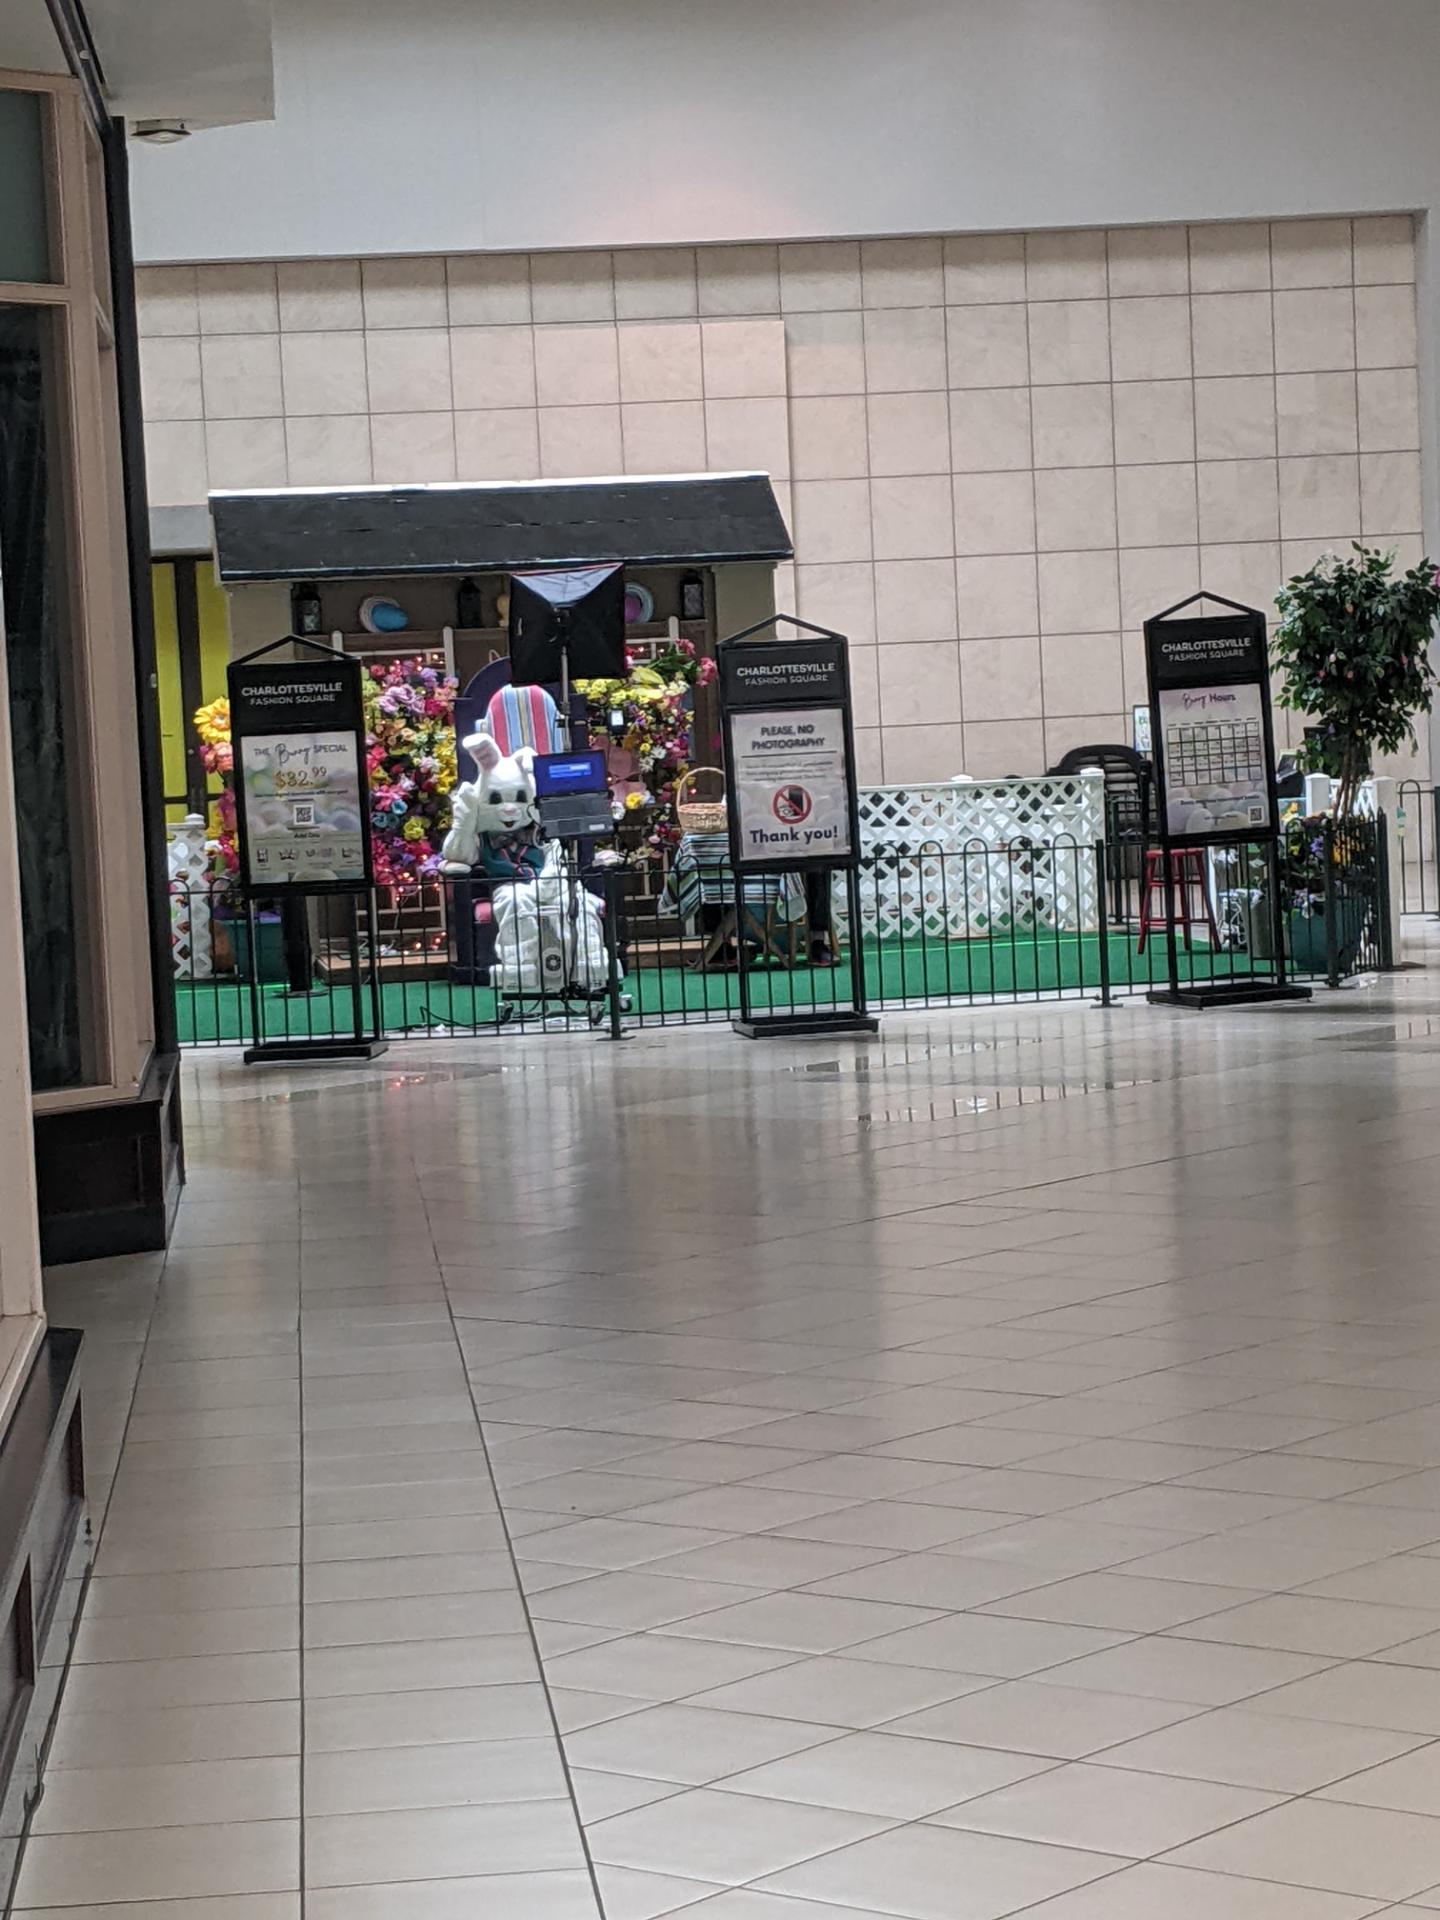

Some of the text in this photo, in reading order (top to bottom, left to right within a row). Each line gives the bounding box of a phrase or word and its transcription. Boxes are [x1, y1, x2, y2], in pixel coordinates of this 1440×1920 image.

[1161, 637, 1251, 653] CHARLOTTESVILLE
[1169, 649, 1244, 662] FASHION SQUARE
[736, 662, 835, 677] CHARLOTTESVILLE
[745, 674, 829, 686] FASHION SQUARE
[241, 681, 342, 697] CHARLOTTESVILLE
[250, 694, 336, 706] FASHION SQUARE
[760, 724, 815, 737] PLEASE, NO
[313, 743, 348, 754] SPECIAL
[751, 738, 825, 750] PHOTOGRAPHY
[749, 825, 838, 845] Thank you!
